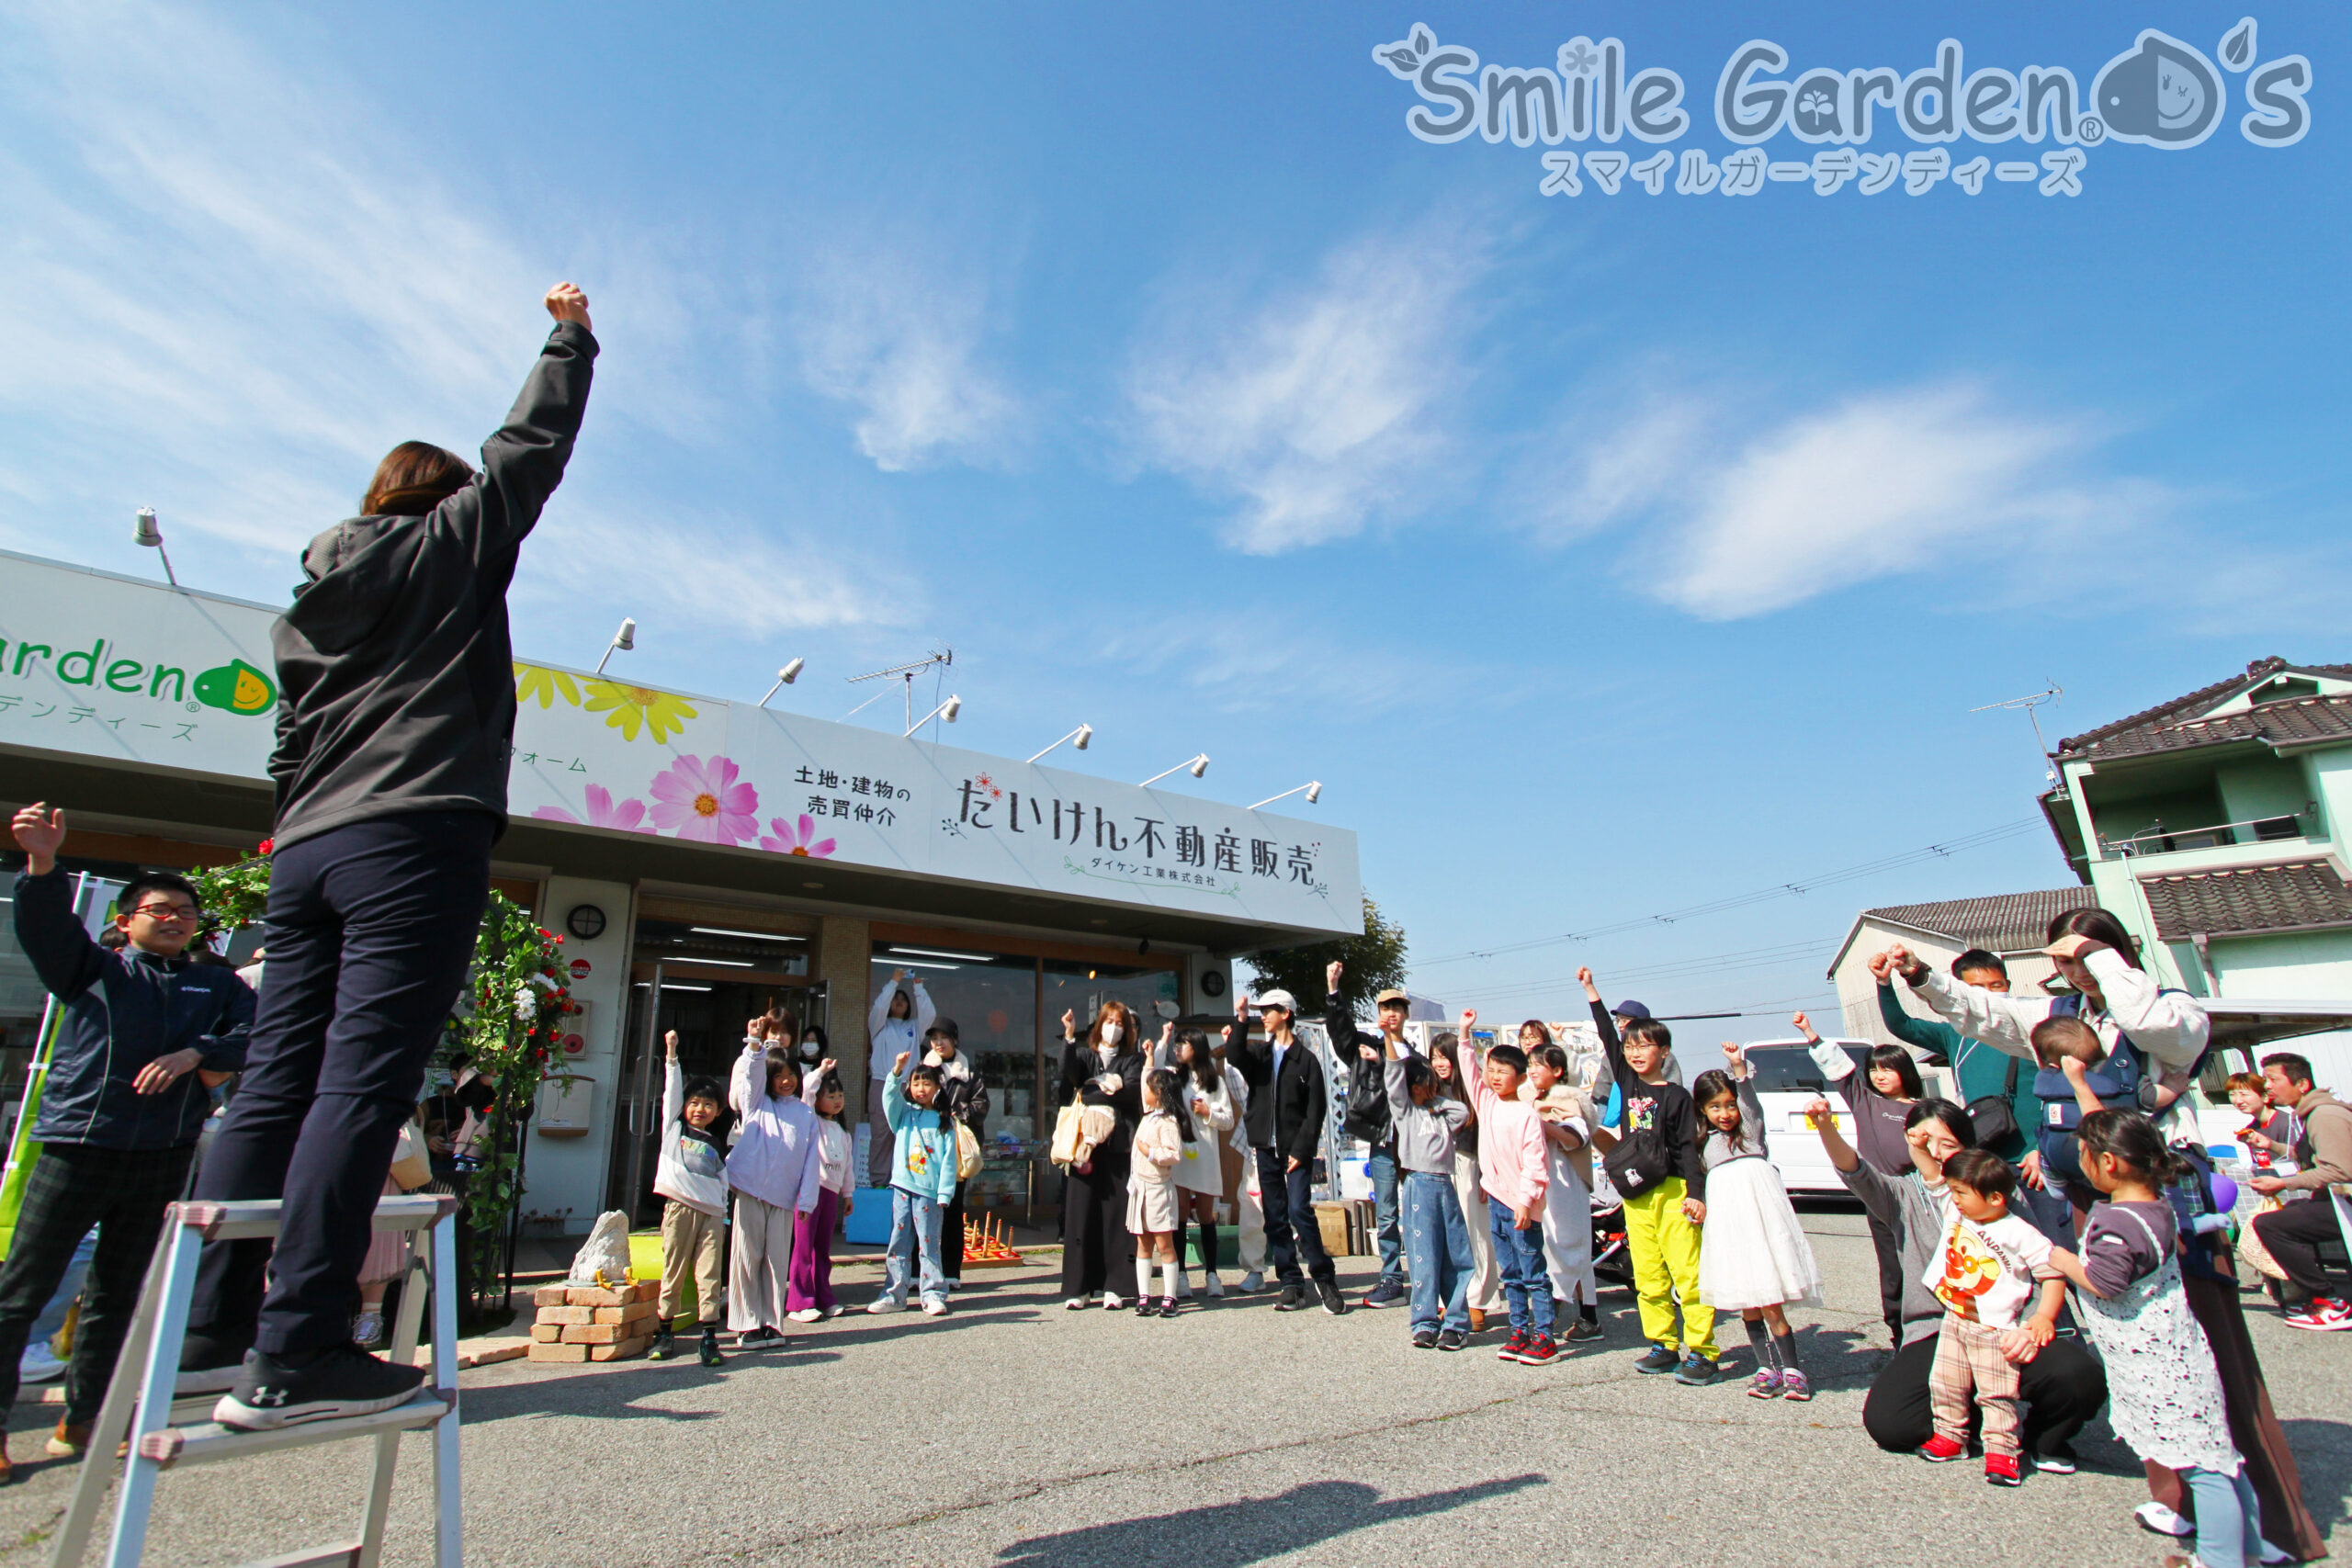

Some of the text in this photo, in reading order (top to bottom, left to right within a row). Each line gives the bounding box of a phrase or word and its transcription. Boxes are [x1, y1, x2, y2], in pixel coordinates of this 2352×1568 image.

[807, 795, 897, 827] 売買仲介
[1091, 857, 1216, 887] ダイケン工業株式会社
